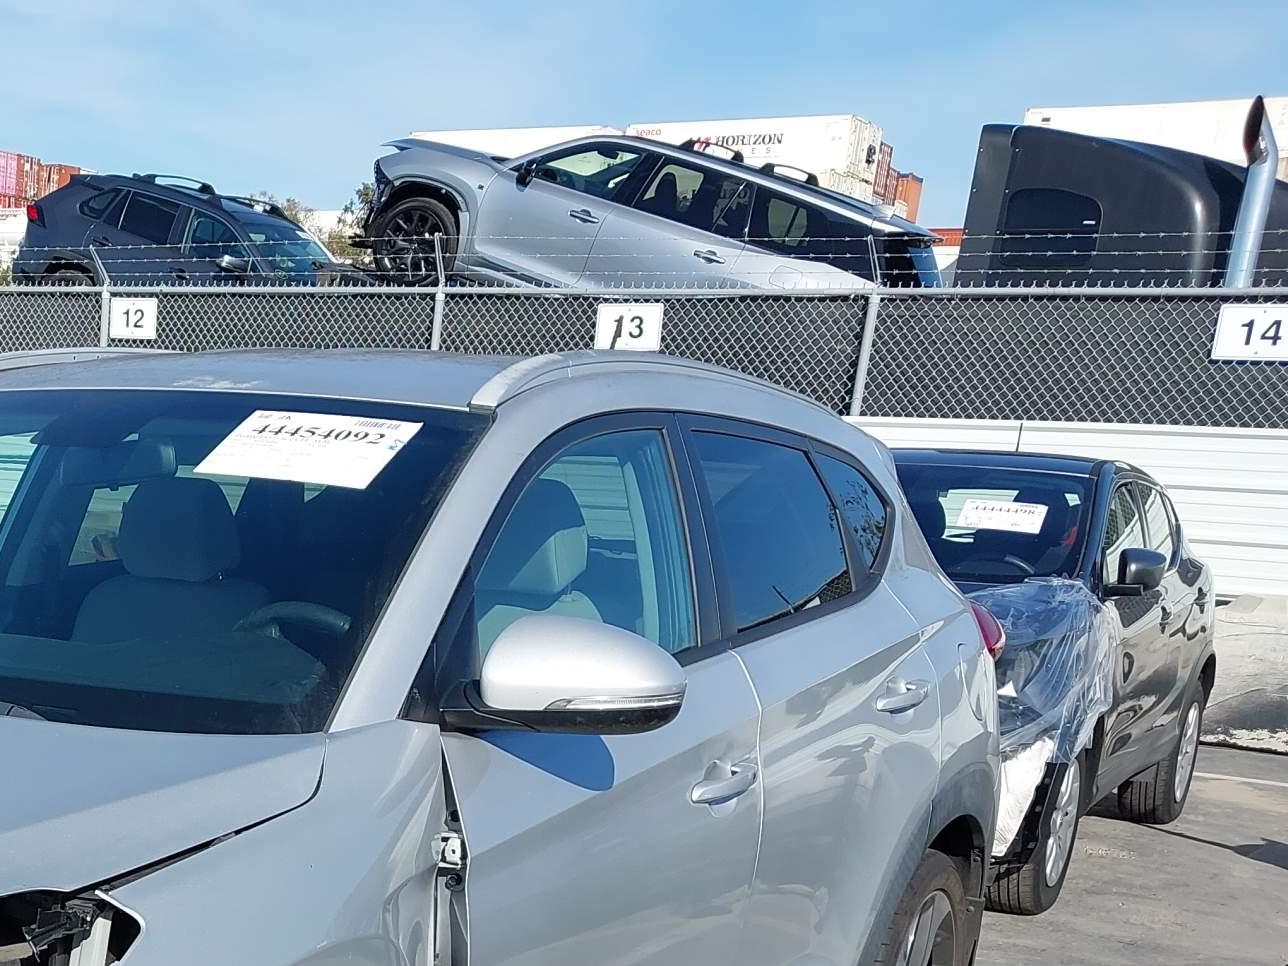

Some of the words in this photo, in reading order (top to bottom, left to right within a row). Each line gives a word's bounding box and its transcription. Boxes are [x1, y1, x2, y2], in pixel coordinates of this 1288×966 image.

[715, 133, 784, 147] HORIZON
[122, 308, 145, 329] 12
[613, 315, 644, 339] 13
[1240, 318, 1283, 346] 14
[252, 423, 387, 445] 44454092
